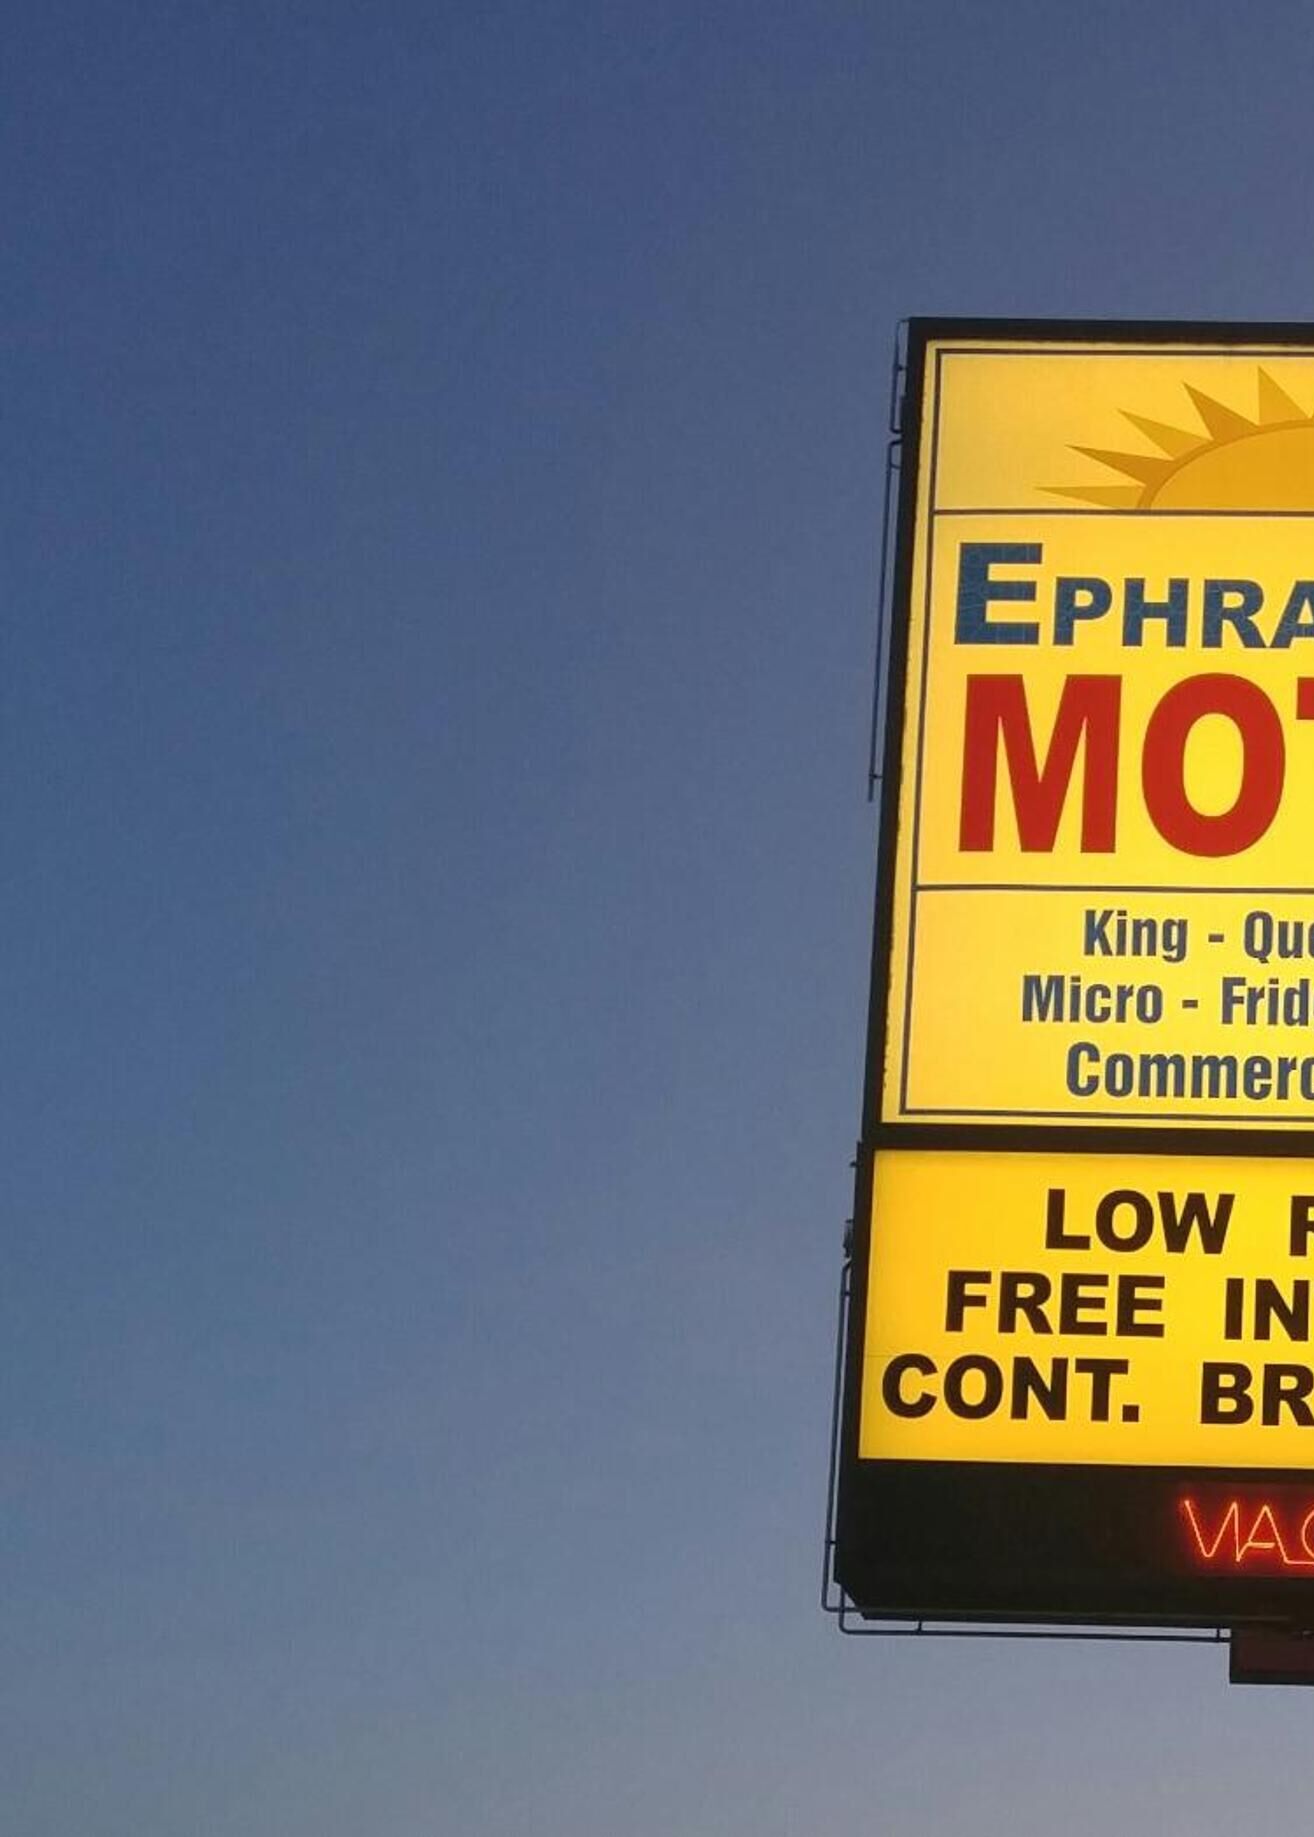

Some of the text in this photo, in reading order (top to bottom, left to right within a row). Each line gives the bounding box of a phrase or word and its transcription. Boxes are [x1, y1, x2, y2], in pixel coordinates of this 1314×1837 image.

[1085, 910, 1187, 962] King
[1023, 976, 1162, 1023] Micro
[1046, 1189, 1235, 1254] LOW
[945, 1270, 1165, 1337] FREE
[882, 1353, 1139, 1422] CONT.
